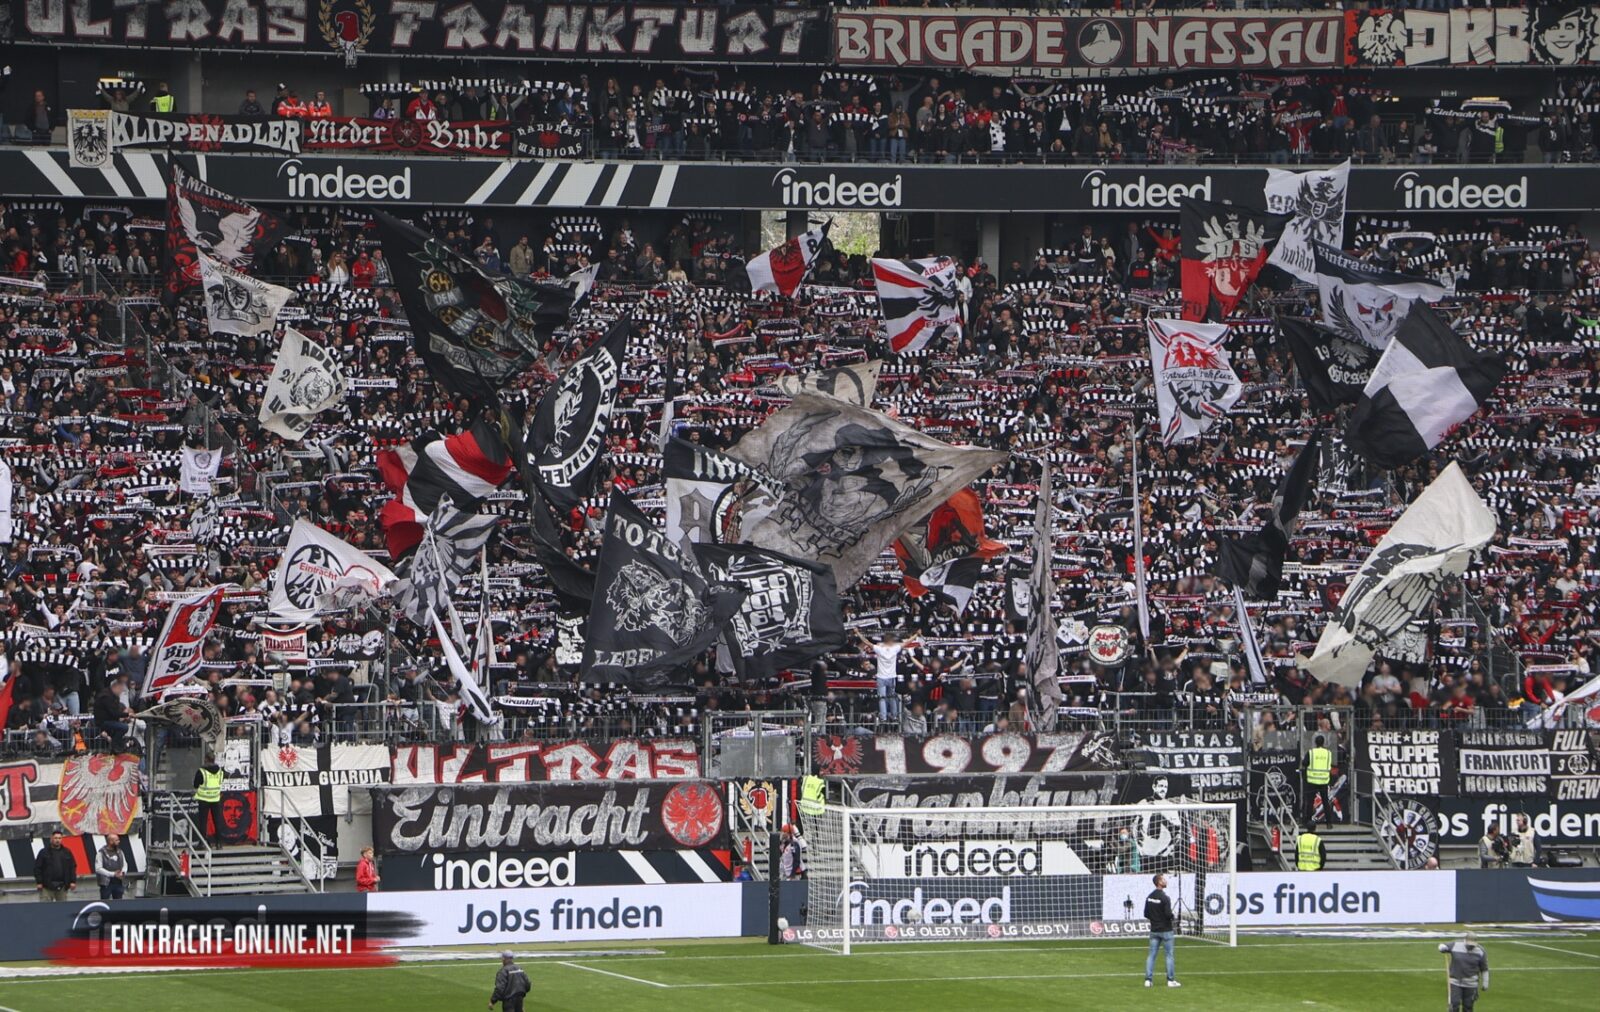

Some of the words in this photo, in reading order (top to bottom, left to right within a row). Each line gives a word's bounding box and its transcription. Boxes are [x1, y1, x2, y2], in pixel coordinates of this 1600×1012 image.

[25, 0, 307, 42] ULTRAS
[389, 2, 820, 54] FRANKFURT
[836, 16, 1067, 67] BRIGADE
[1134, 15, 1341, 68] NASSAU
[1012, 67, 1170, 79] HOOLIGANS
[112, 112, 302, 154] KLIPPENADLER
[307, 119, 388, 146] Nieder
[428, 119, 503, 151] Bube
[518, 142, 582, 157] WARRIORS
[286, 163, 411, 199] indeed
[780, 174, 902, 207] indeed
[1089, 175, 1212, 207] indeed
[1404, 175, 1528, 208] indeed
[1317, 246, 1384, 275] Eintracht
[299, 562, 338, 581] Eintracht
[1149, 733, 1235, 747] ULTRAS
[1367, 730, 1401, 745] EHRE
[1412, 730, 1440, 744] DER
[1552, 730, 1587, 751] FULL
[392, 740, 700, 785] ULTRAS
[874, 732, 1089, 774] 1997
[1158, 753, 1230, 768] NEVER
[1368, 745, 1440, 762] GRUPPE
[1464, 753, 1549, 771] FRANKFURT
[265, 771, 313, 787] NUOVA
[319, 768, 383, 785] GUARDIA
[1190, 772, 1243, 788] ENDER
[1371, 761, 1441, 778] STADION
[1373, 777, 1441, 795] VERBOT
[1465, 775, 1547, 793] HOOLIGANS
[1557, 778, 1600, 801] CREW
[390, 785, 650, 850] Eintracht
[853, 774, 1119, 840] Frankfurt
[902, 839, 1043, 877] indeed
[433, 851, 576, 889] indeed
[850, 885, 1011, 926] indeed
[1205, 884, 1265, 916] obs
[1274, 882, 1380, 916] finden
[457, 900, 541, 934] Jobs
[550, 897, 663, 931] finden
[797, 930, 813, 939] LG
[899, 928, 915, 937] LG
[919, 927, 950, 937] OLED
[951, 926, 968, 936] TV
[1002, 926, 1018, 936] LG
[1022, 925, 1052, 935] OLED
[1053, 924, 1070, 935] TV
[1105, 923, 1120, 933] LG
